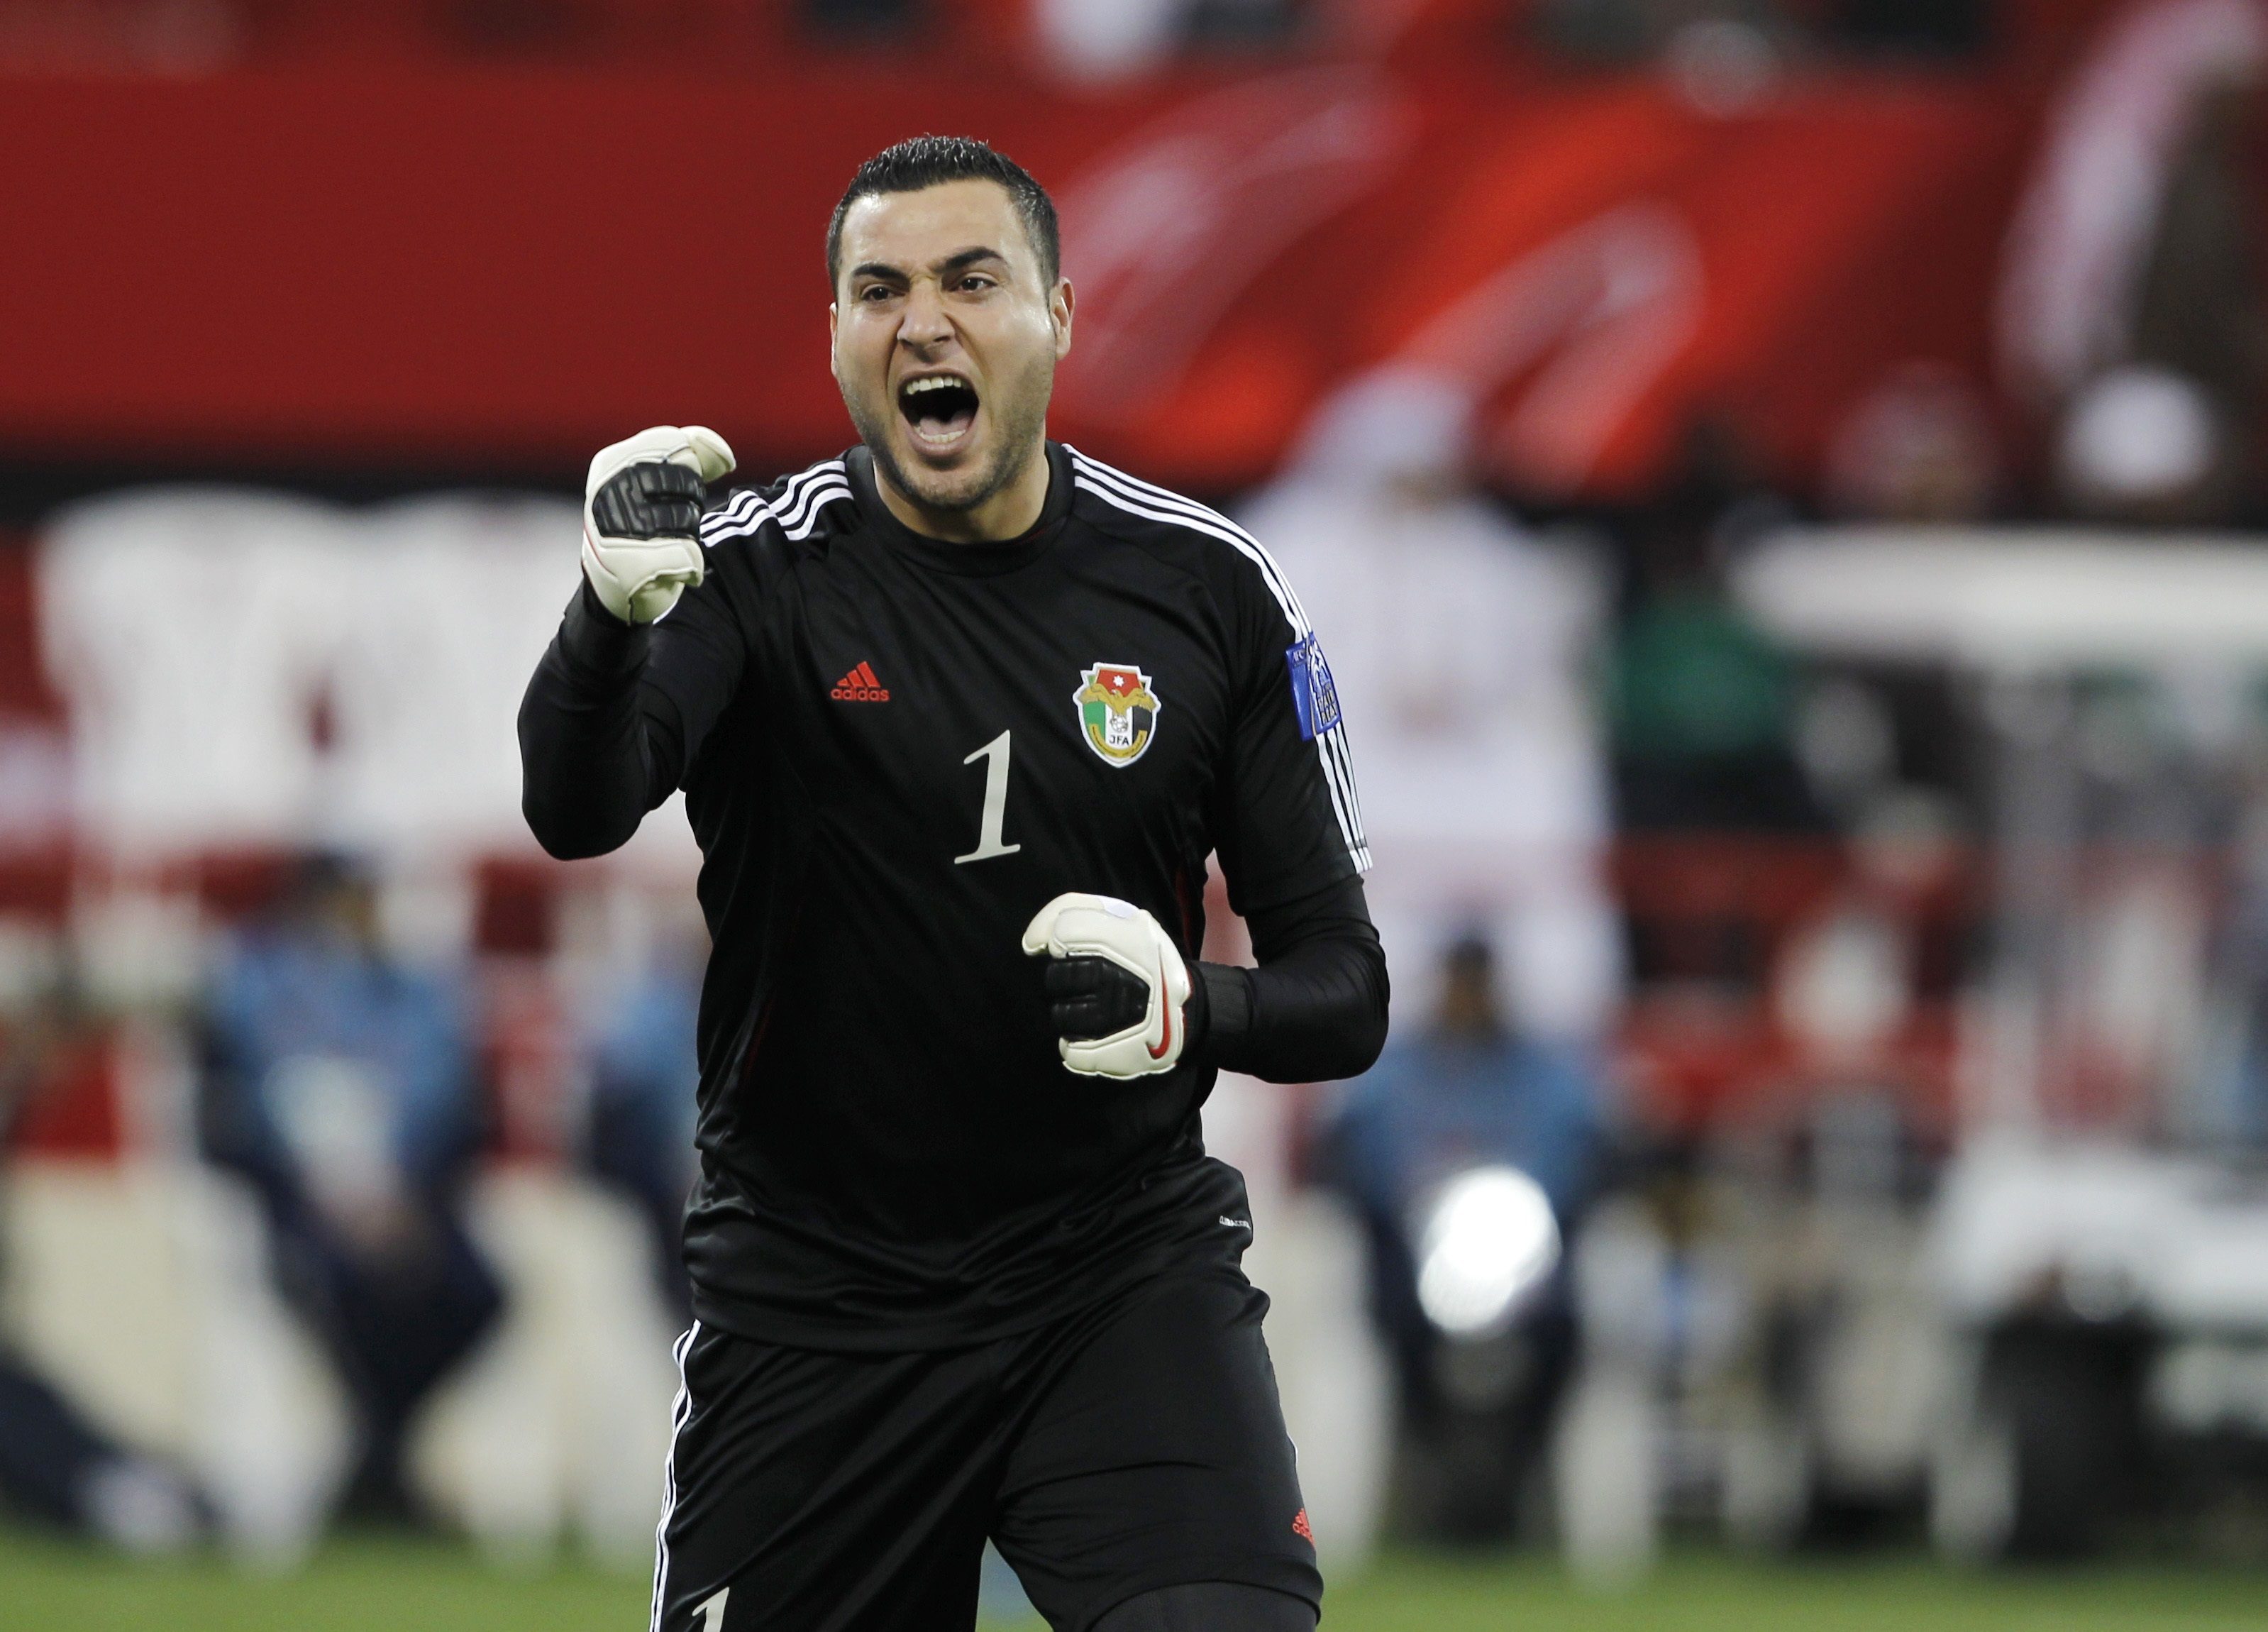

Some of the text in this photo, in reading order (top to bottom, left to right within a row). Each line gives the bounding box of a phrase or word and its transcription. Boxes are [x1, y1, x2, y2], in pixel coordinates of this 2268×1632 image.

[830, 686, 890, 702] adidas
[1109, 734, 1130, 746] JFA
[954, 729, 1021, 864] 1
